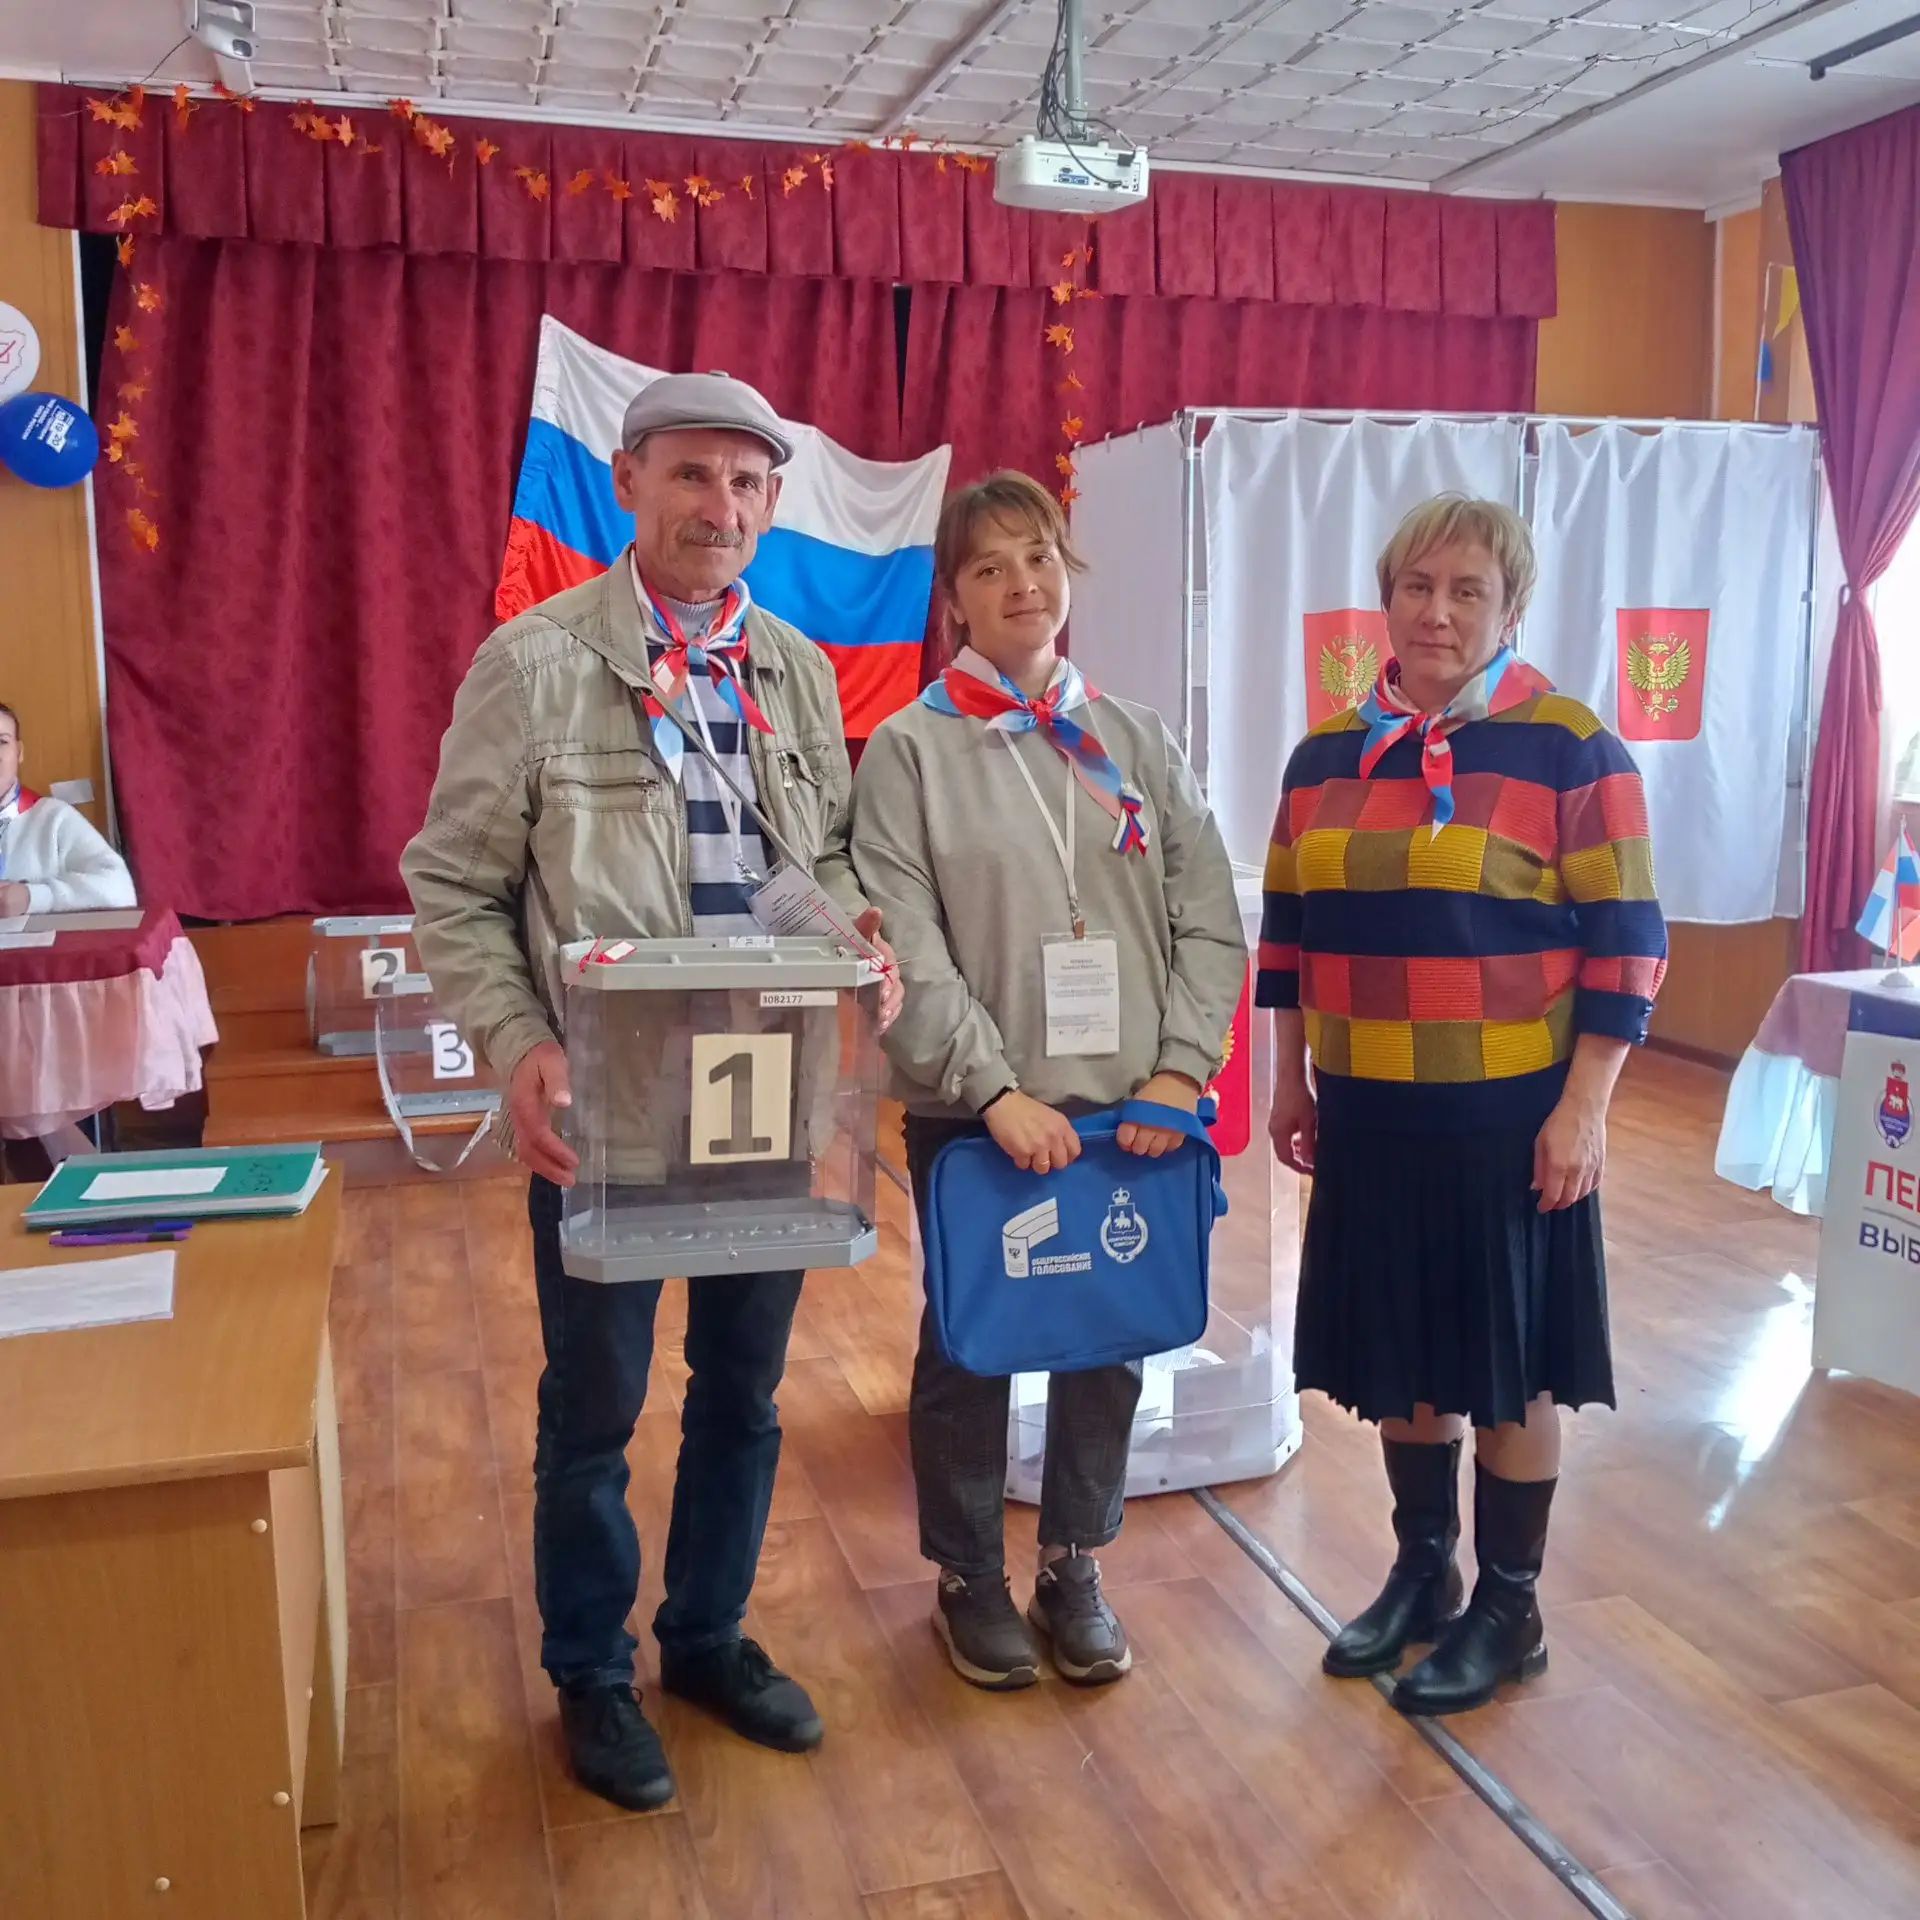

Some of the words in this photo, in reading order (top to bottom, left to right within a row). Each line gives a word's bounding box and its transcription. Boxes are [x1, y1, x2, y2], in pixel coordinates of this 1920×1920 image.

[370, 951, 398, 995] 2
[439, 1029, 468, 1073] 3
[708, 1051, 772, 1156] 1
[1864, 1160, 1920, 1213] ПЕ
[1031, 1260, 1092, 1276] ГОЛОСОВАНИЕ
